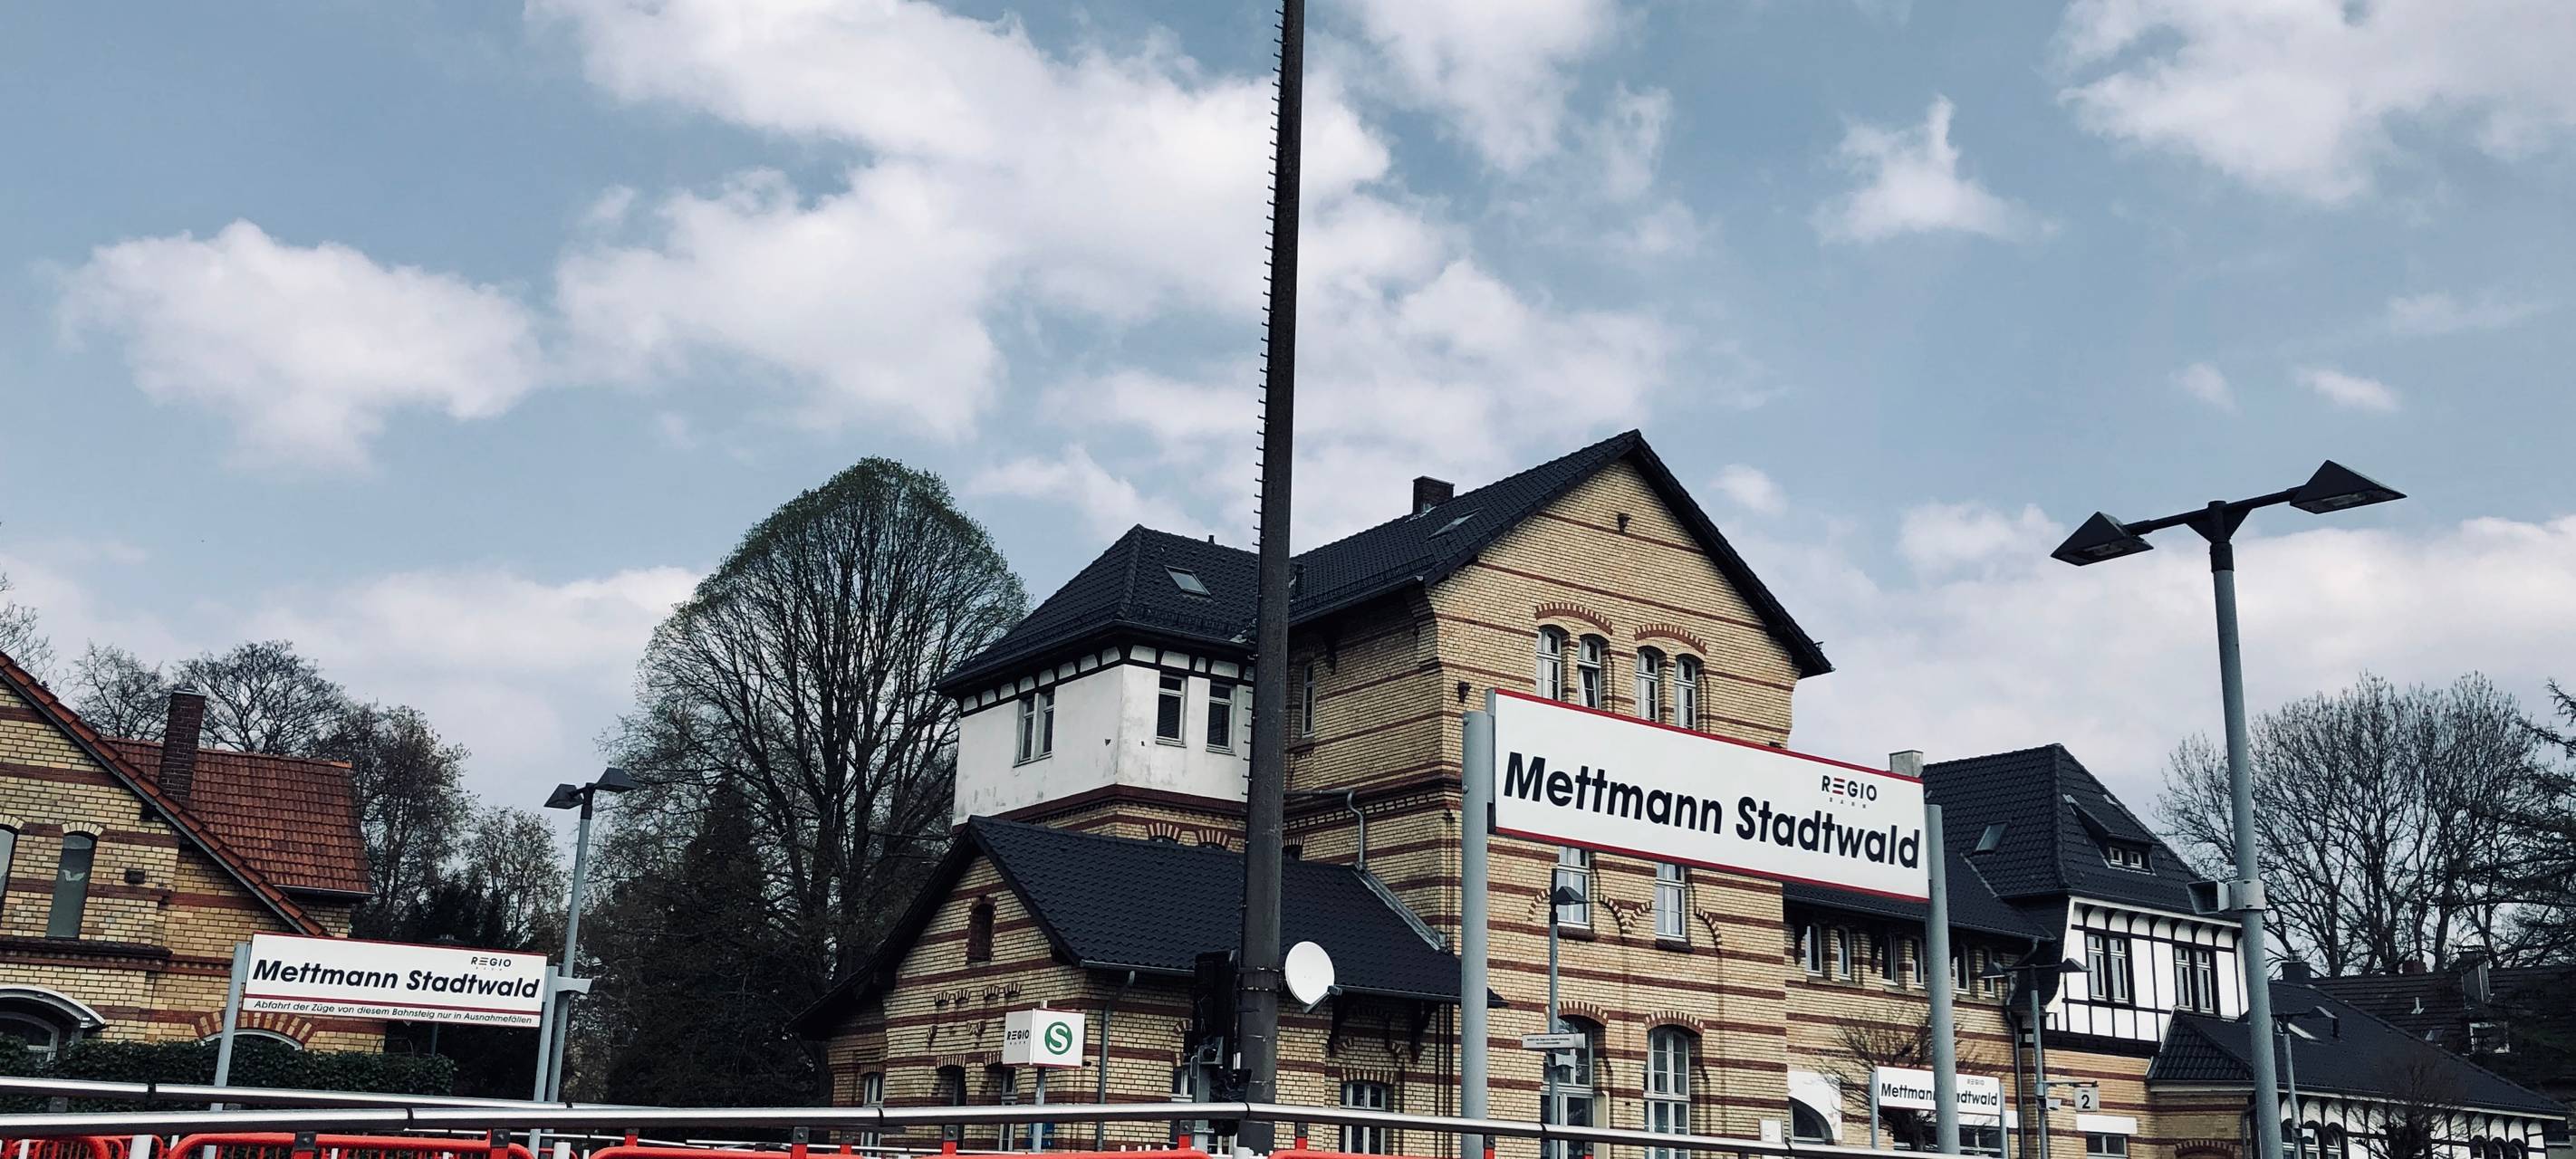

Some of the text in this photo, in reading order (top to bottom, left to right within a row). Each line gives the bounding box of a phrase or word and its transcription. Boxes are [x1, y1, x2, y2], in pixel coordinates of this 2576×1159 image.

[1821, 775, 1878, 801] REGIO
[1503, 751, 1921, 869] Mettmann Stadtwald
[470, 956, 512, 968] REGIO
[252, 959, 541, 999] Mettmann Stadtwald
[254, 1000, 533, 1024] Abfahrt der Züge von diesem Bahnsteig nur in Ausnahmefällen
[1006, 1030, 1030, 1040] REGIO
[1047, 1023, 1070, 1052] S
[1880, 1083, 1935, 1101] Mettman
[2081, 1094, 2091, 1109] 2
